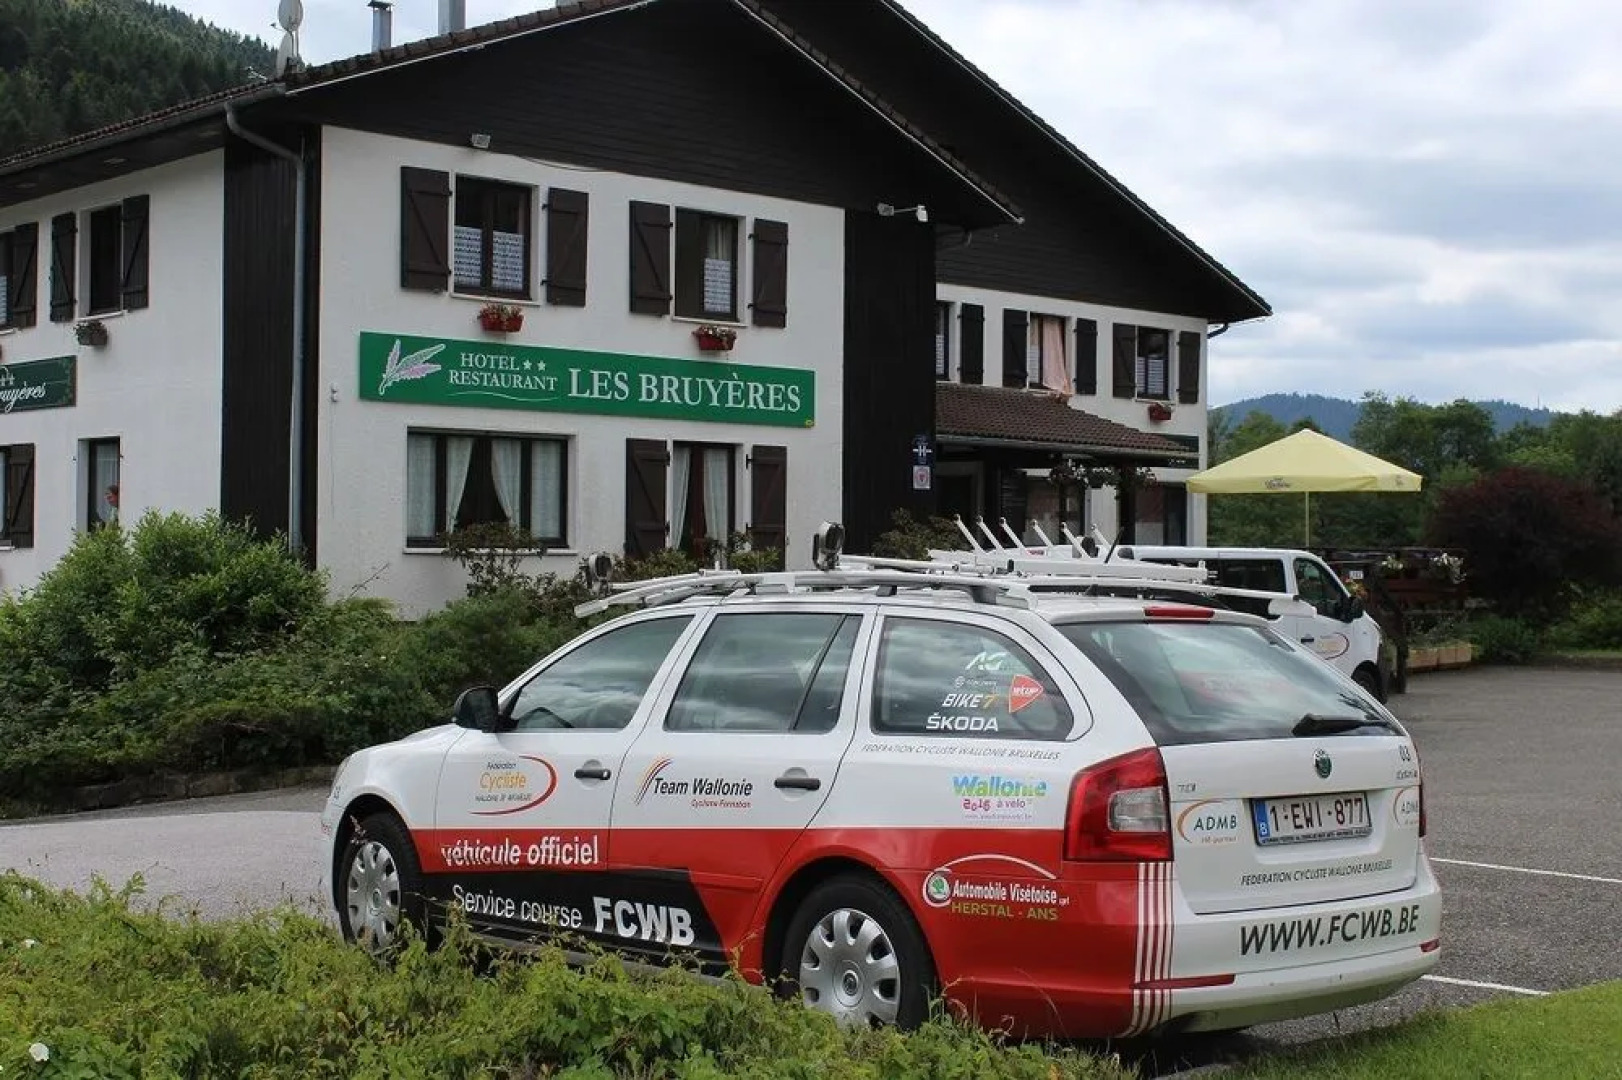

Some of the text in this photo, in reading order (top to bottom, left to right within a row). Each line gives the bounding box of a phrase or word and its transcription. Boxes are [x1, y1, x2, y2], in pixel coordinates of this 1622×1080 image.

[460, 352, 519, 371] HOTEL
[449, 370, 558, 391] RESTAURANT
[568, 367, 801, 412] LES BRUYÈRES
[925, 713, 999, 731] ŠKODA
[1007, 750, 1060, 760] BRUXELLES
[480, 772, 526, 791] Cycliste
[653, 777, 753, 796] Team Wallonie
[953, 775, 1047, 797] Wallonie
[1193, 815, 1237, 831] ADMB
[441, 835, 599, 867] véhicule officiel
[1241, 871, 1292, 886] FEDERATION
[1293, 868, 1327, 881] CYCLISTE
[951, 879, 1008, 901] Automobile
[1009, 883, 1057, 904] Visétoise
[452, 884, 695, 946] Service course FCWB
[951, 902, 1015, 918] HERSTAL
[1026, 907, 1059, 921] ANS
[1240, 904, 1420, 956] WWW.FCWB.BE
